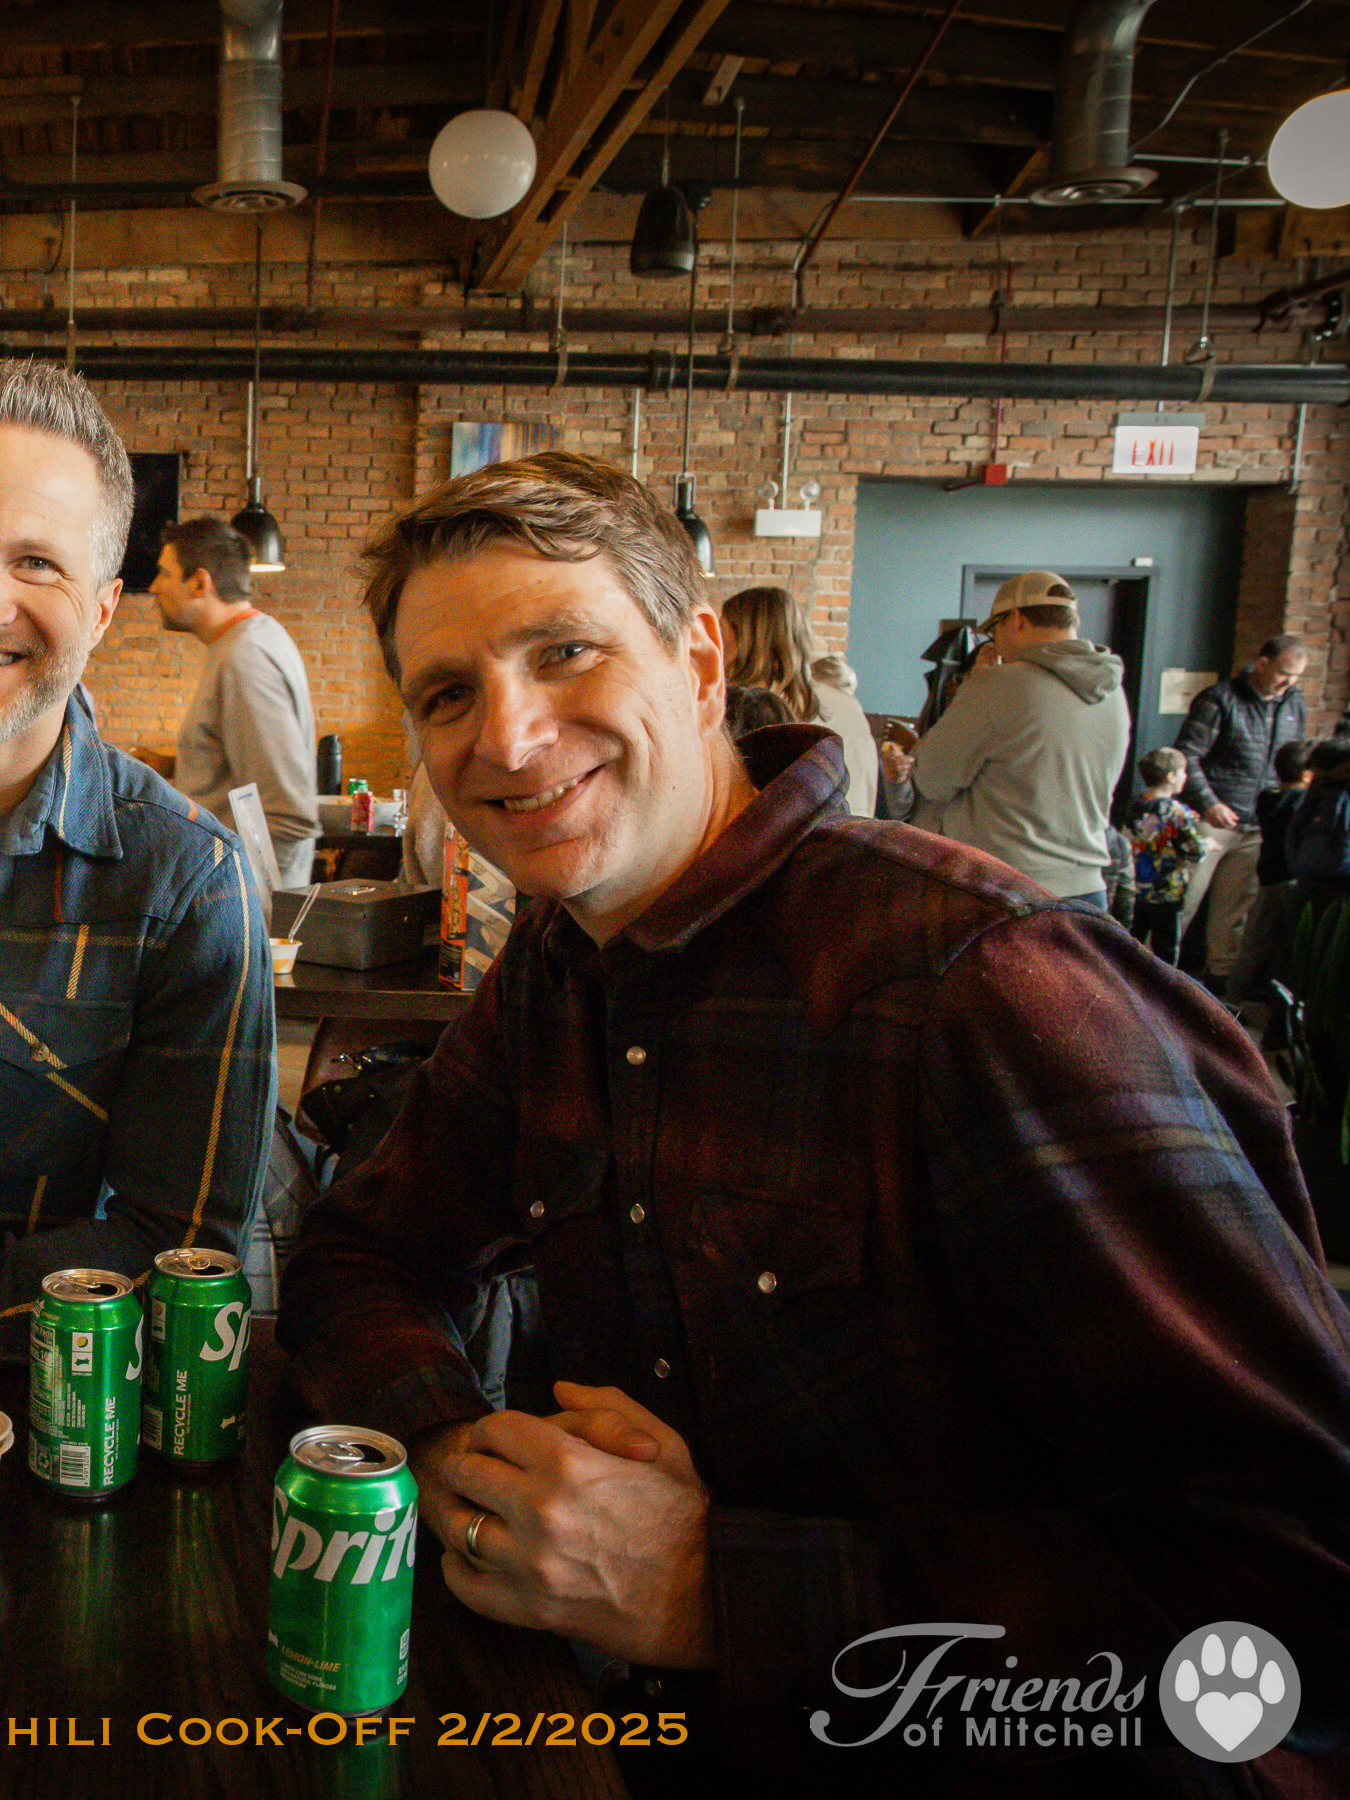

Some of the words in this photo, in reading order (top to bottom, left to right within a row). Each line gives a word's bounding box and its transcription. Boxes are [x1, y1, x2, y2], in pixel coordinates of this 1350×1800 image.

[175, 1369, 188, 1392] ME
[105, 1396, 116, 1420] ME
[173, 1393, 187, 1456] RECYCLE
[103, 1421, 116, 1486] RECYCLE
